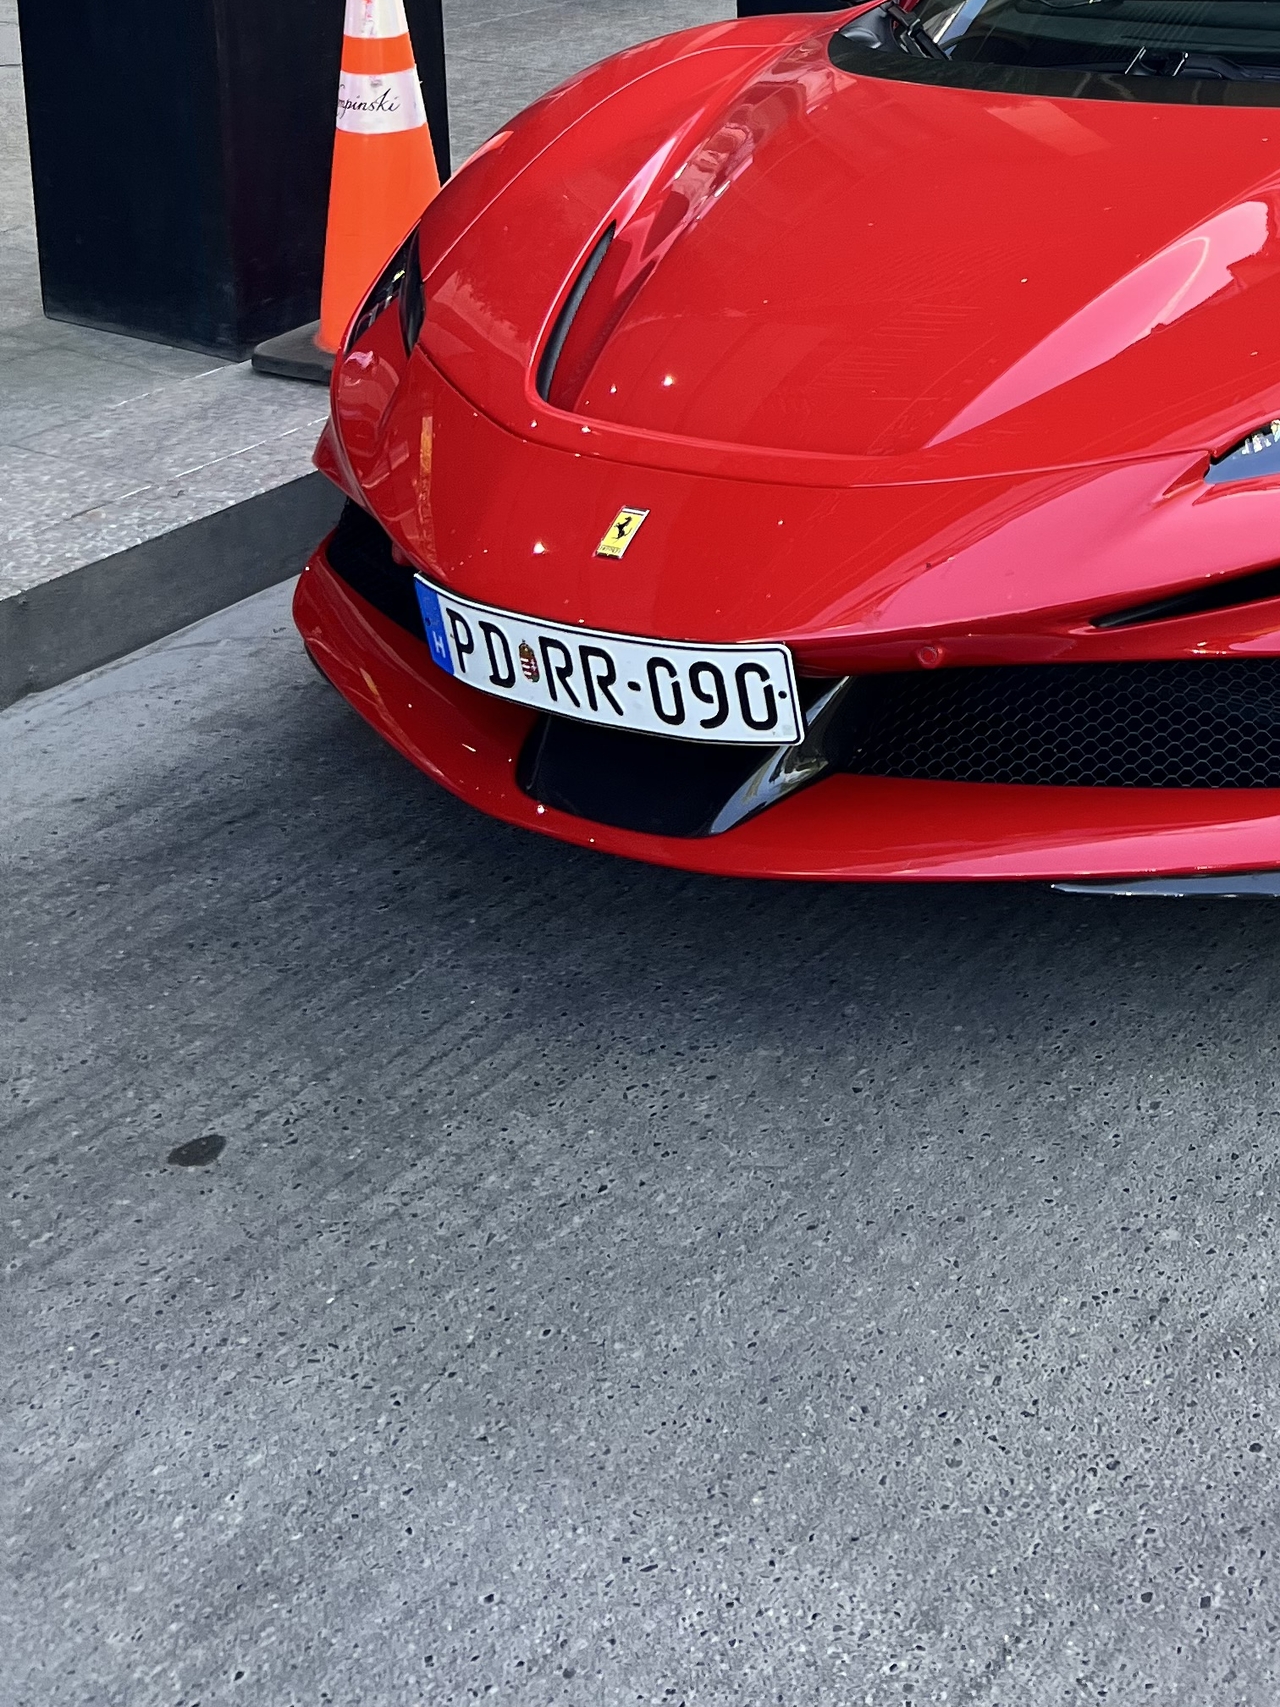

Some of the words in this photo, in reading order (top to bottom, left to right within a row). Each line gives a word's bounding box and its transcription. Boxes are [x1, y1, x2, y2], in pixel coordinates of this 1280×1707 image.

[432, 630, 446, 659] H
[446, 607, 516, 689] PD
[539, 636, 780, 731] RR-090
